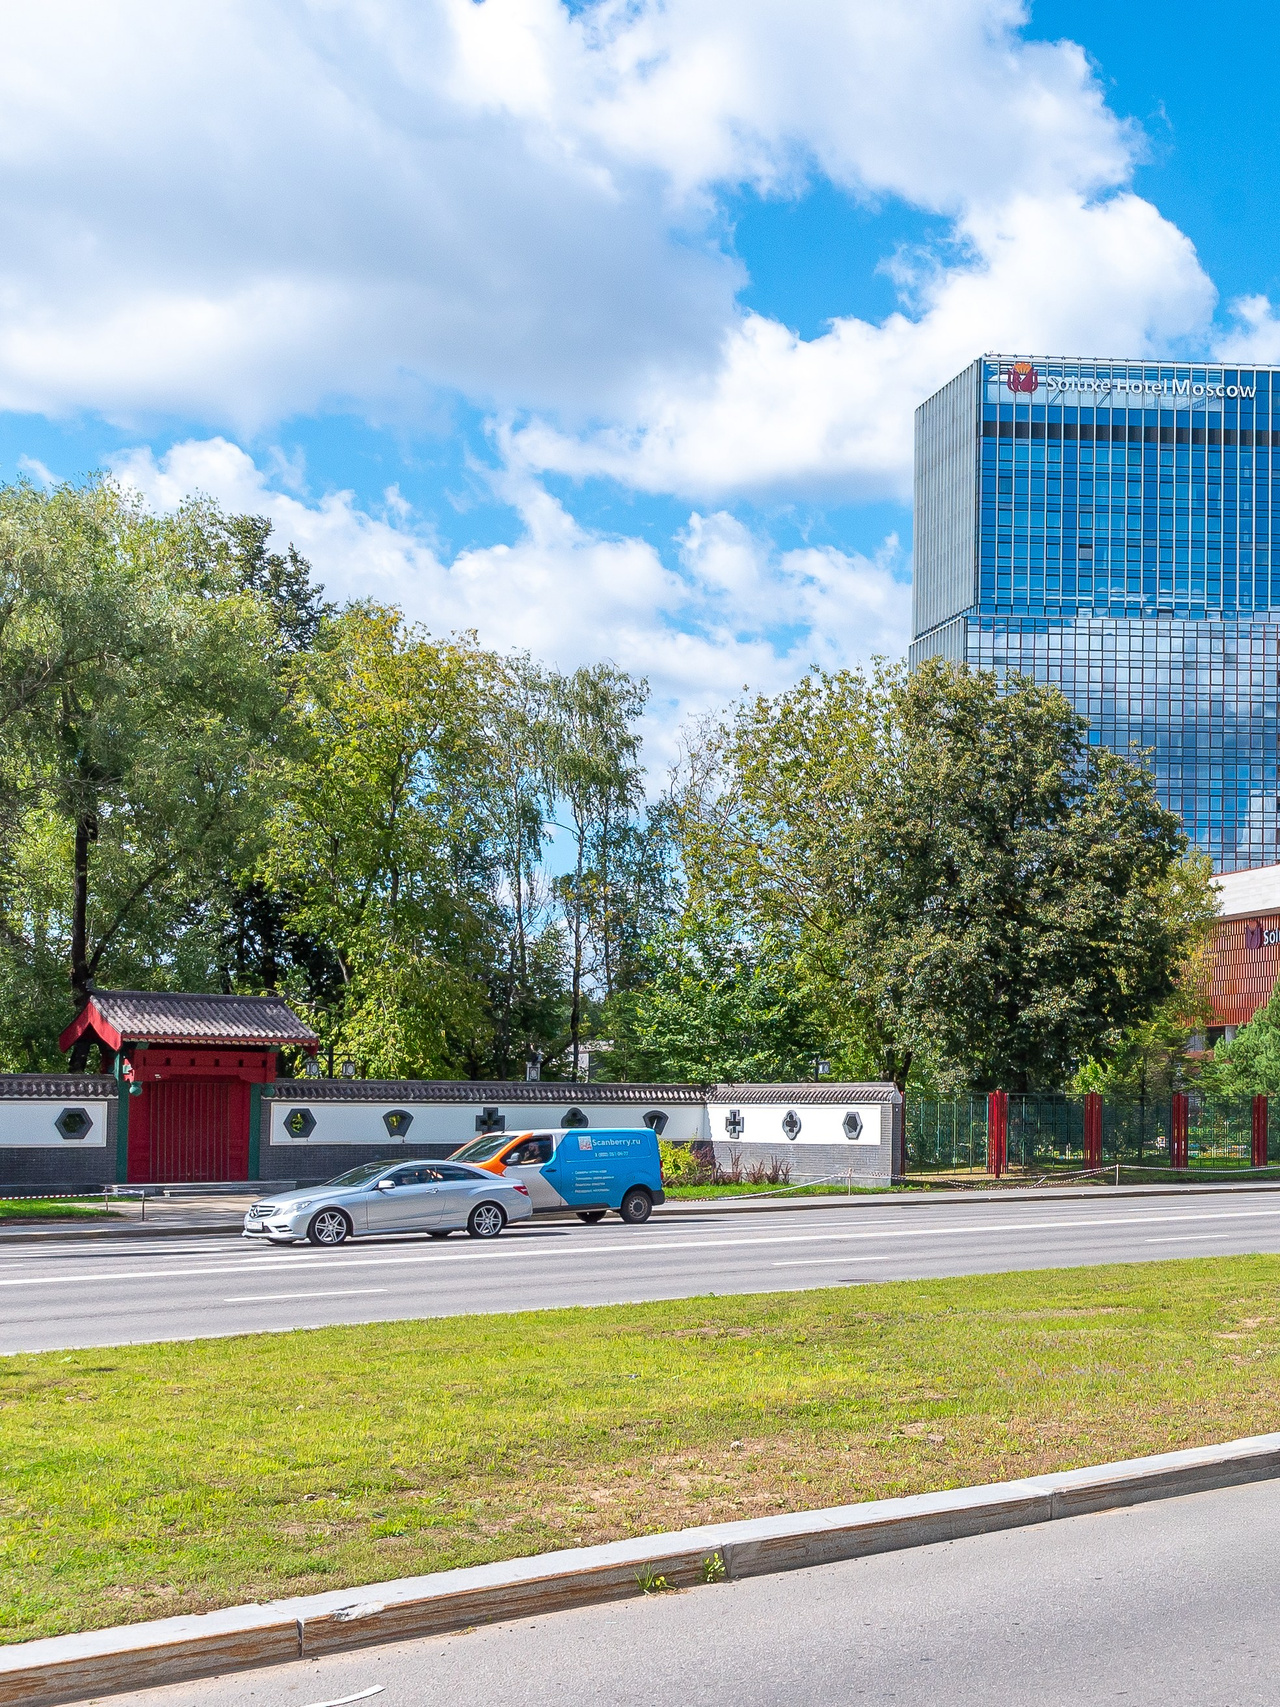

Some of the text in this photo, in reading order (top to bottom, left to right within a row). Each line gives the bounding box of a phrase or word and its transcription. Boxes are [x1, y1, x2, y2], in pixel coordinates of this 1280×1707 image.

[1046, 375, 1257, 398] Soluxe Hotel Moscow
[592, 1138, 641, 1147] Scanberry.ru
